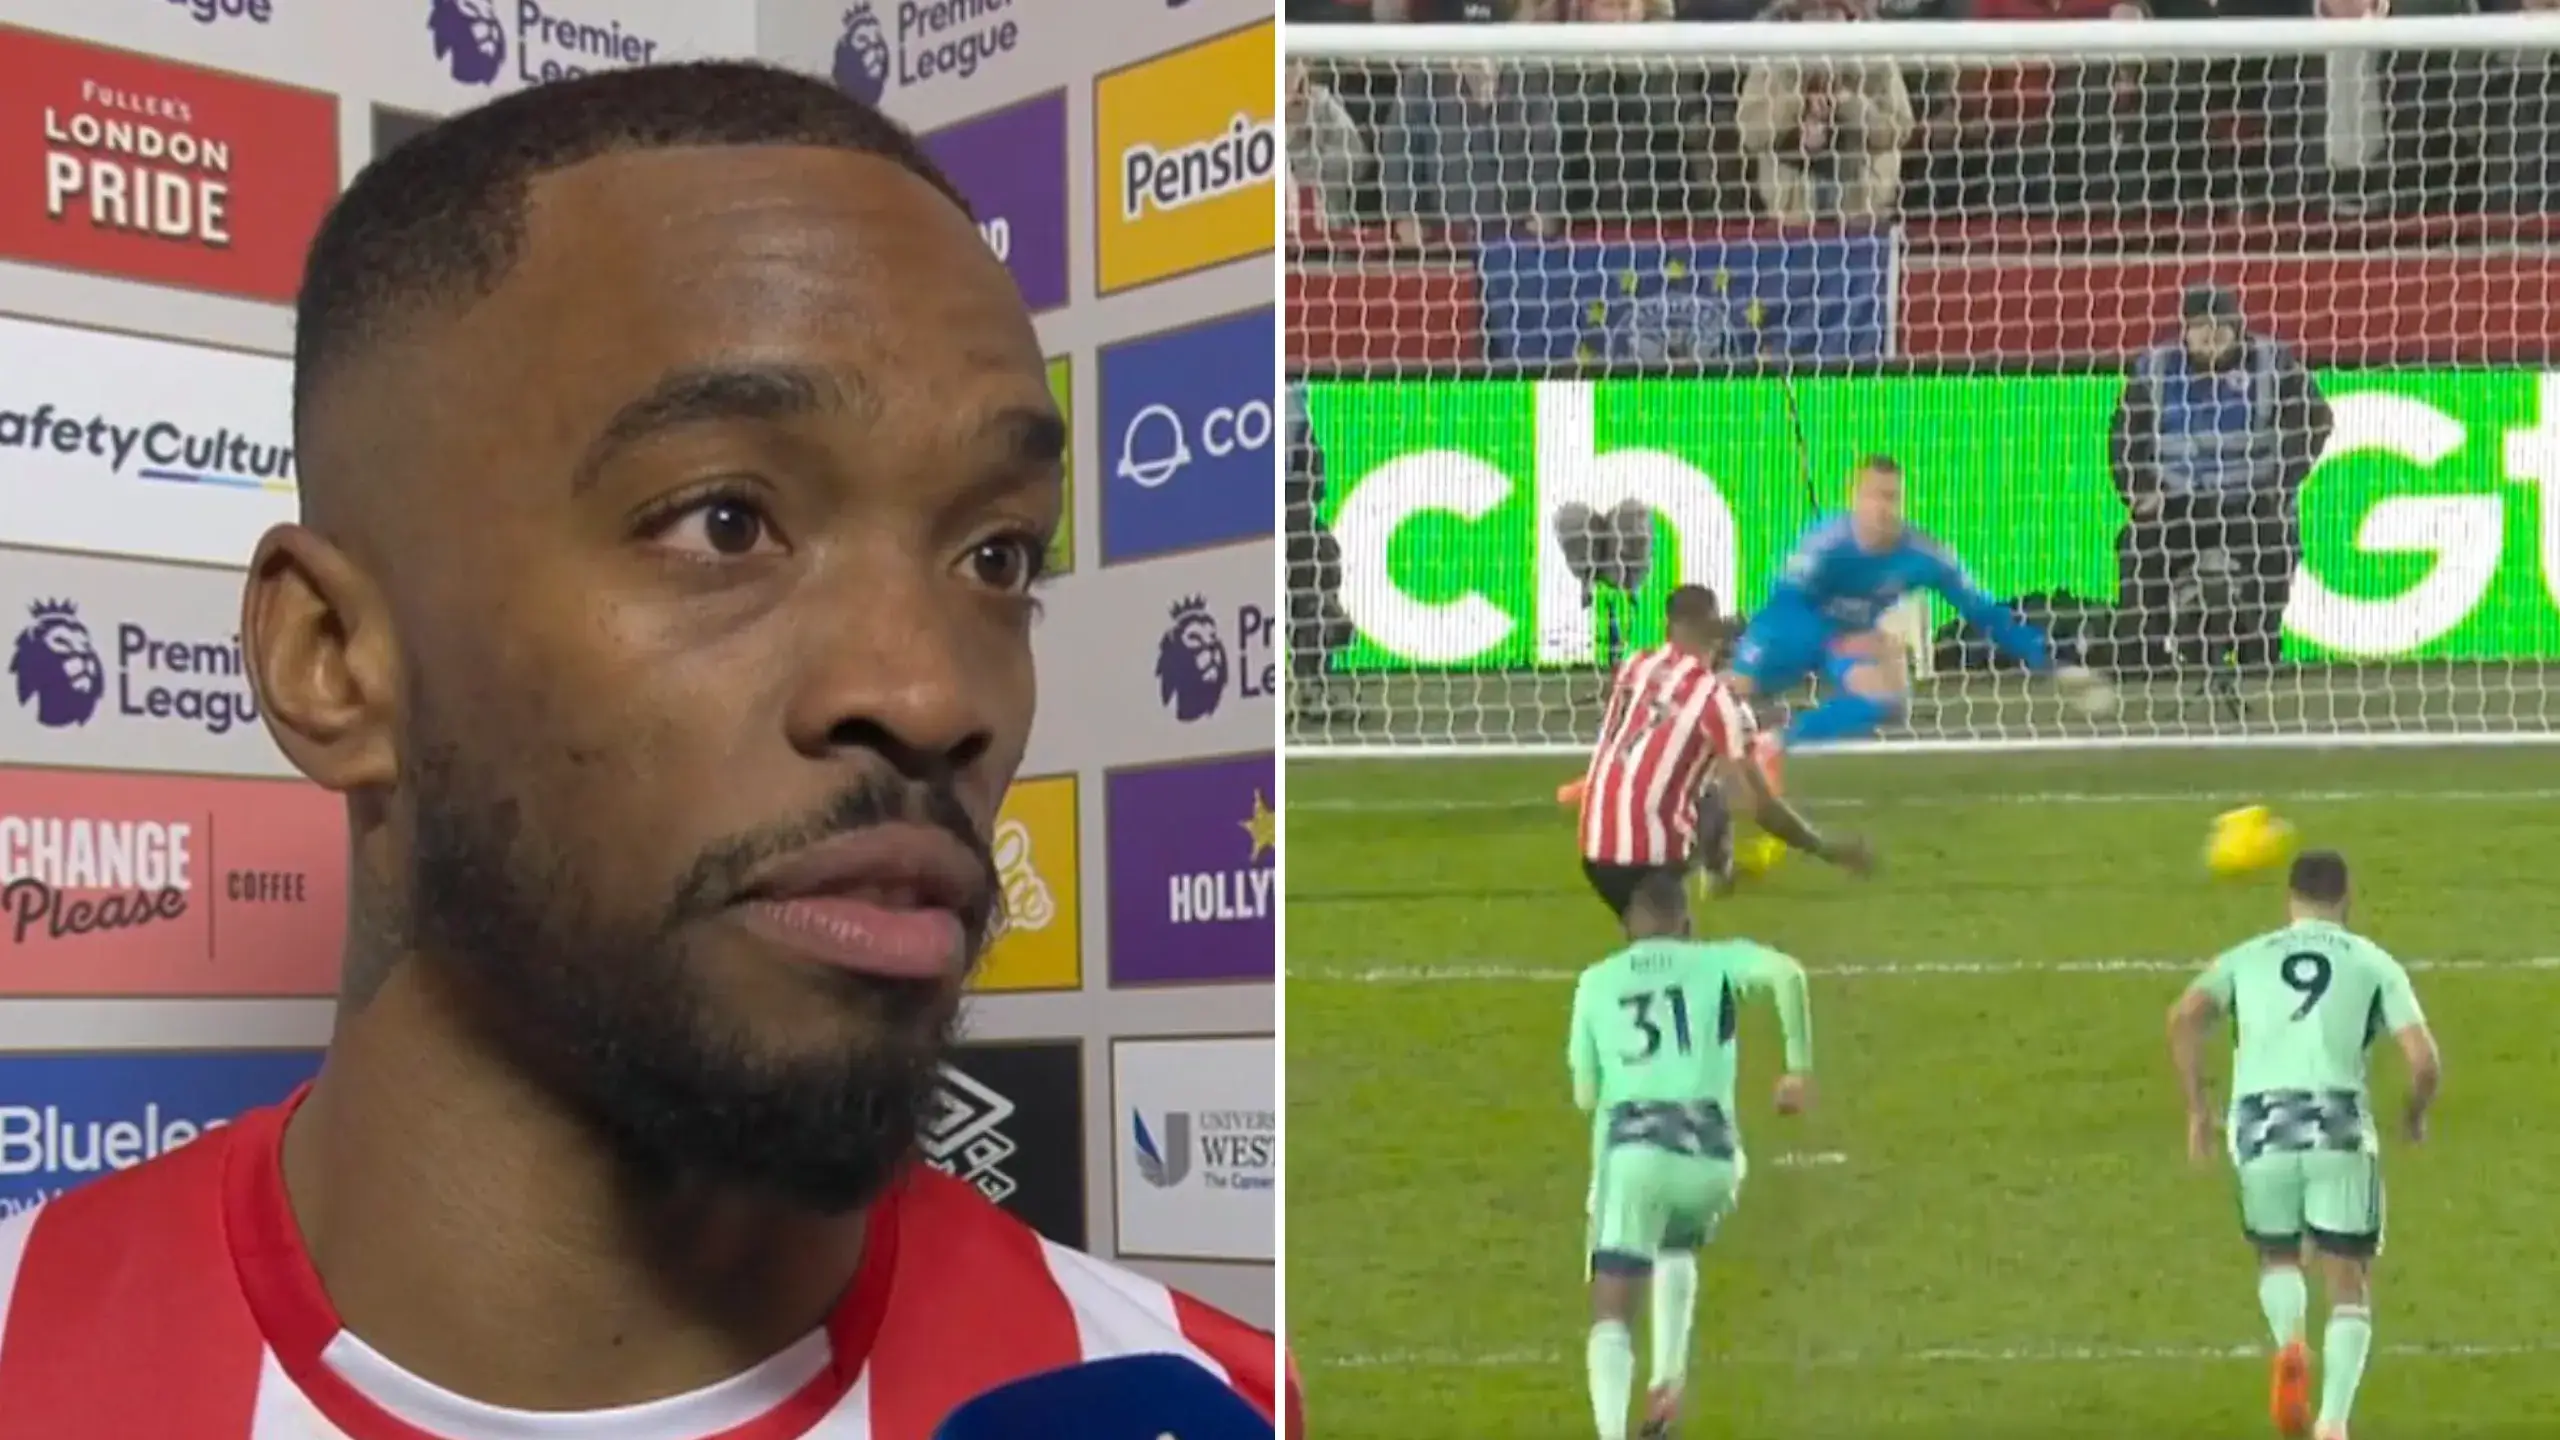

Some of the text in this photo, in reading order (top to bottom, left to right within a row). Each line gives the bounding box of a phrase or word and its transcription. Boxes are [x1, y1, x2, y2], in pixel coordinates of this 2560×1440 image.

[517, 0, 658, 65] Premier
[899, 20, 1017, 86] League
[45, 106, 228, 171] LONDON
[1126, 119, 1275, 216] Pensio
[47, 150, 230, 243] PRIDE
[1202, 400, 1272, 457] CO
[1332, 380, 1737, 664] ch
[0, 815, 192, 891] CHANGE
[227, 869, 307, 903] COFFEE
[2, 877, 187, 944] Please
[1169, 867, 1275, 923] HOLLY
[2281, 950, 2333, 1022] 9
[1618, 983, 1692, 1067] 31
[0, 1103, 231, 1168] Bluele
